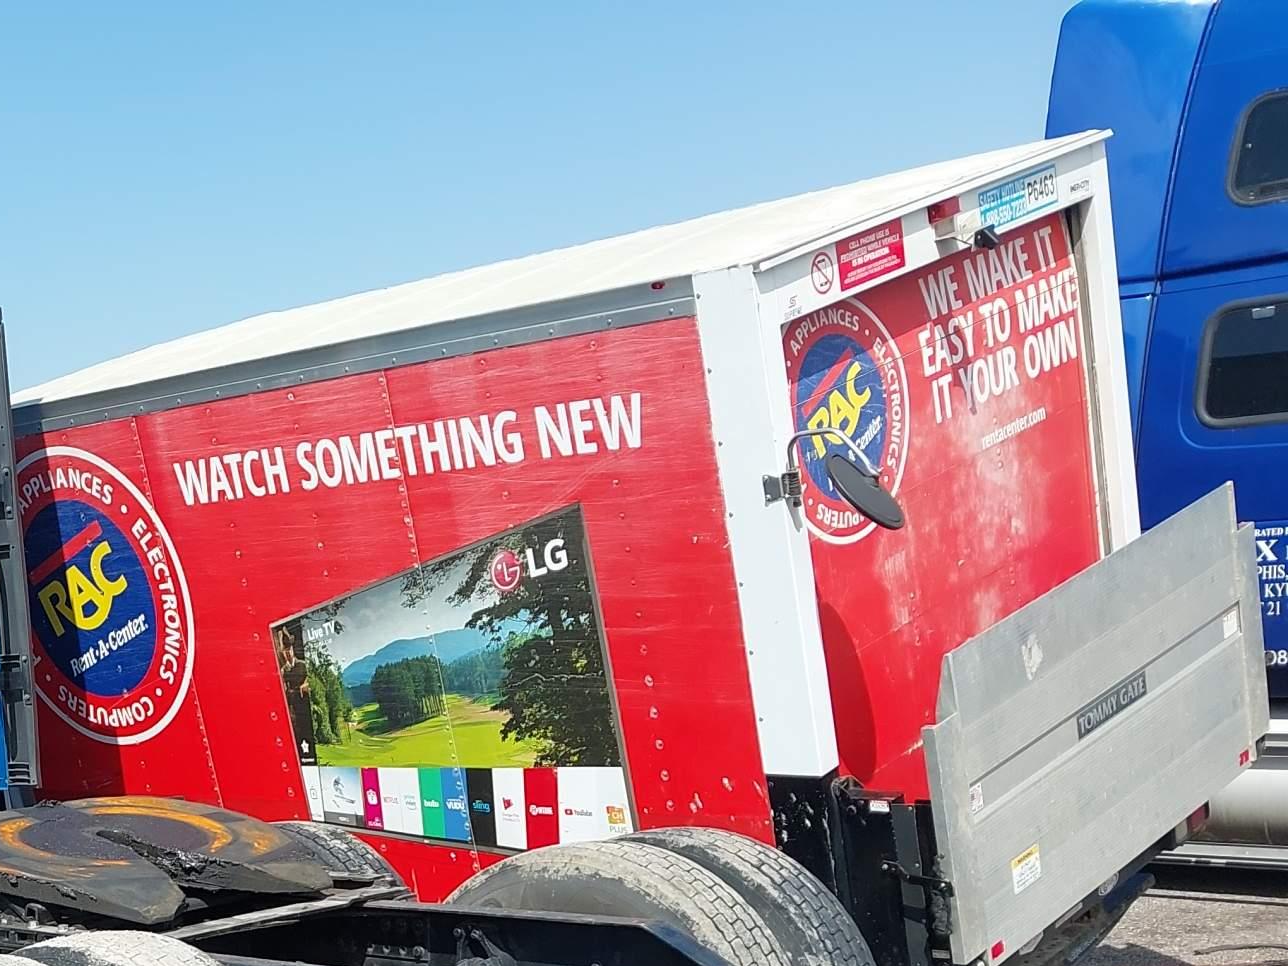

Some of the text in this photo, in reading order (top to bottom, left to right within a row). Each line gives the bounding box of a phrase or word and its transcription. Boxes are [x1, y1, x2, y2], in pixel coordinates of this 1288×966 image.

[1026, 174, 1055, 204] P6463
[918, 226, 1057, 320] WE MAKE IT
[790, 309, 859, 356] APPLIANCES
[917, 267, 1079, 377] EASY TO MAKE
[873, 337, 902, 471] ELECTRONICS
[931, 317, 1078, 424] IT YOUR OWN
[807, 361, 872, 460] RAC
[982, 407, 1047, 450] rentacenter.com
[173, 392, 641, 506] WATCH SOMETHING NEW
[18, 467, 114, 514] APPLIANCES
[37, 540, 128, 638] RAC
[526, 538, 569, 578] LG
[131, 516, 185, 685] ELECTRONICS
[307, 620, 335, 640] Live TV
[58, 684, 155, 727] COMPUTERS
[1078, 677, 1146, 734] TOMMY GATE
